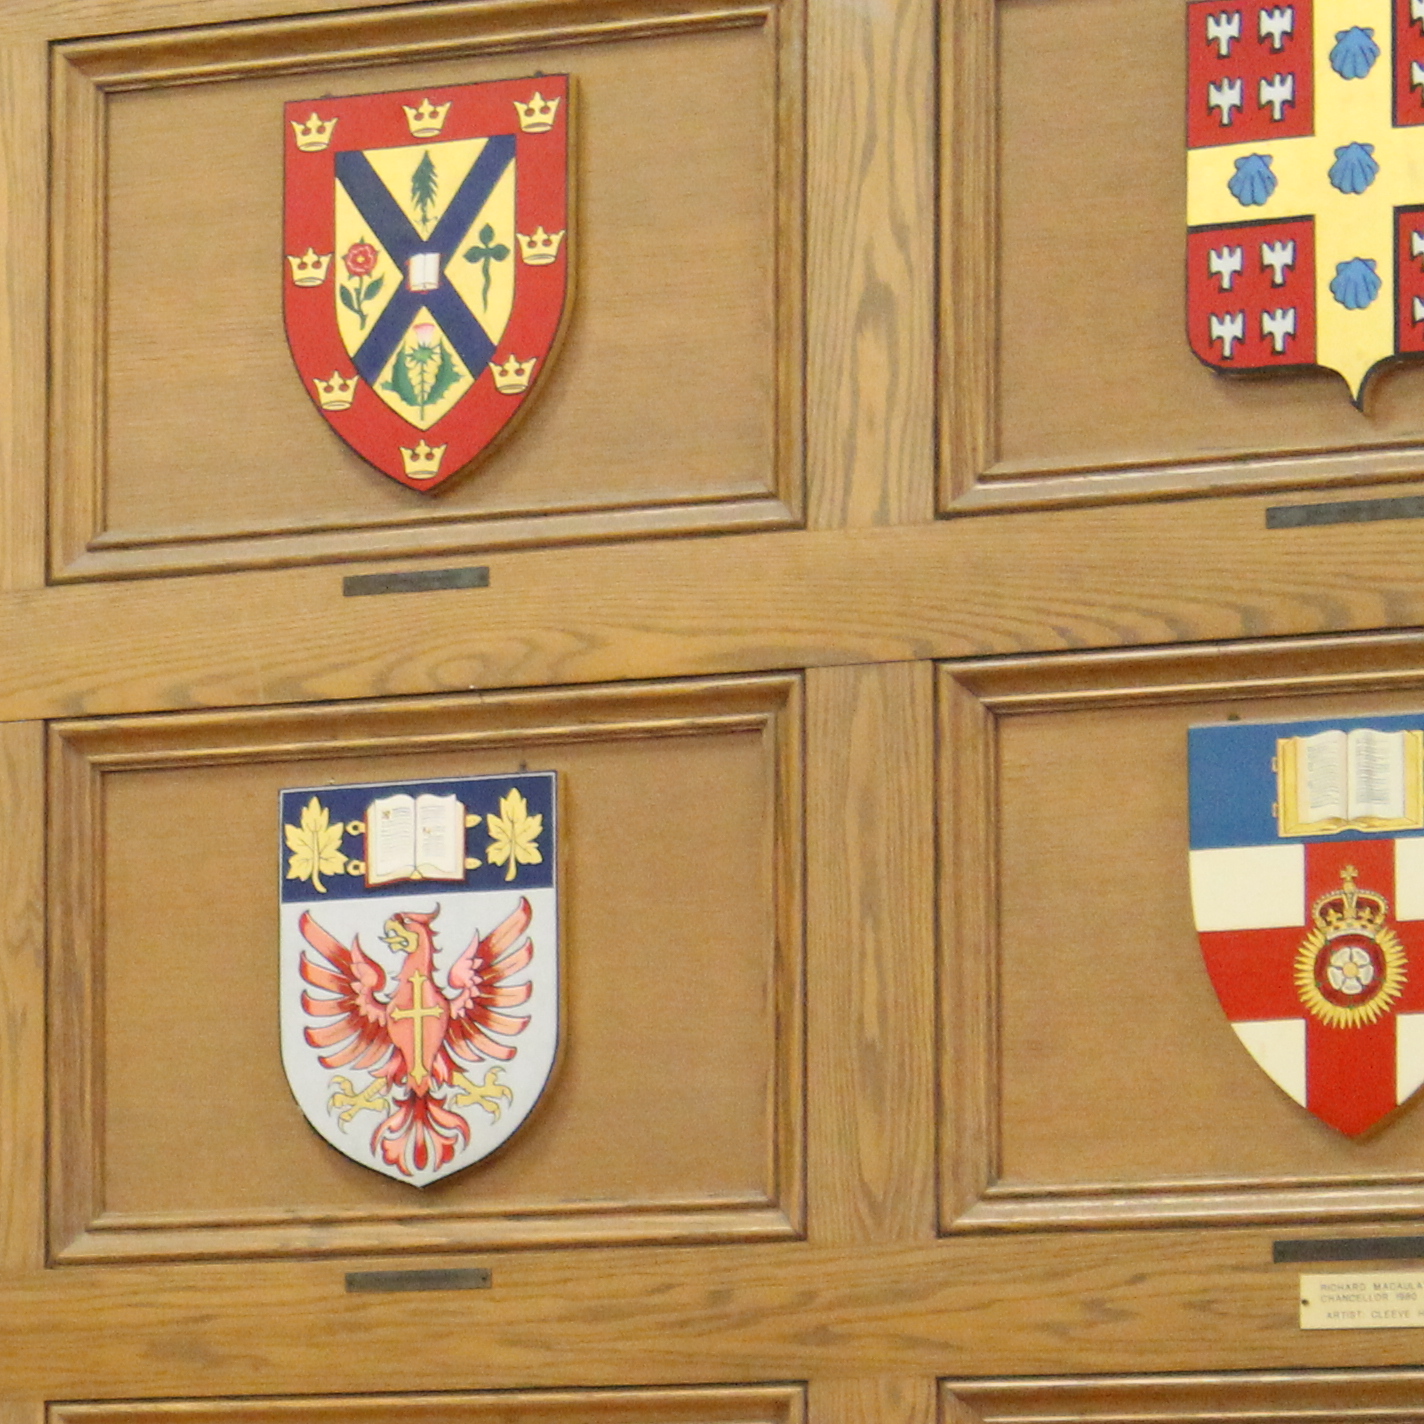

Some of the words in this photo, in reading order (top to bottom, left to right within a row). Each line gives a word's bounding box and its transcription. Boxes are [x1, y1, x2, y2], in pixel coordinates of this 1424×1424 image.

[1320, 1283, 1367, 1292] RICHARD
[1373, 1282, 1424, 1291] MACAULA
[1320, 1293, 1389, 1303] CHANCELLOR
